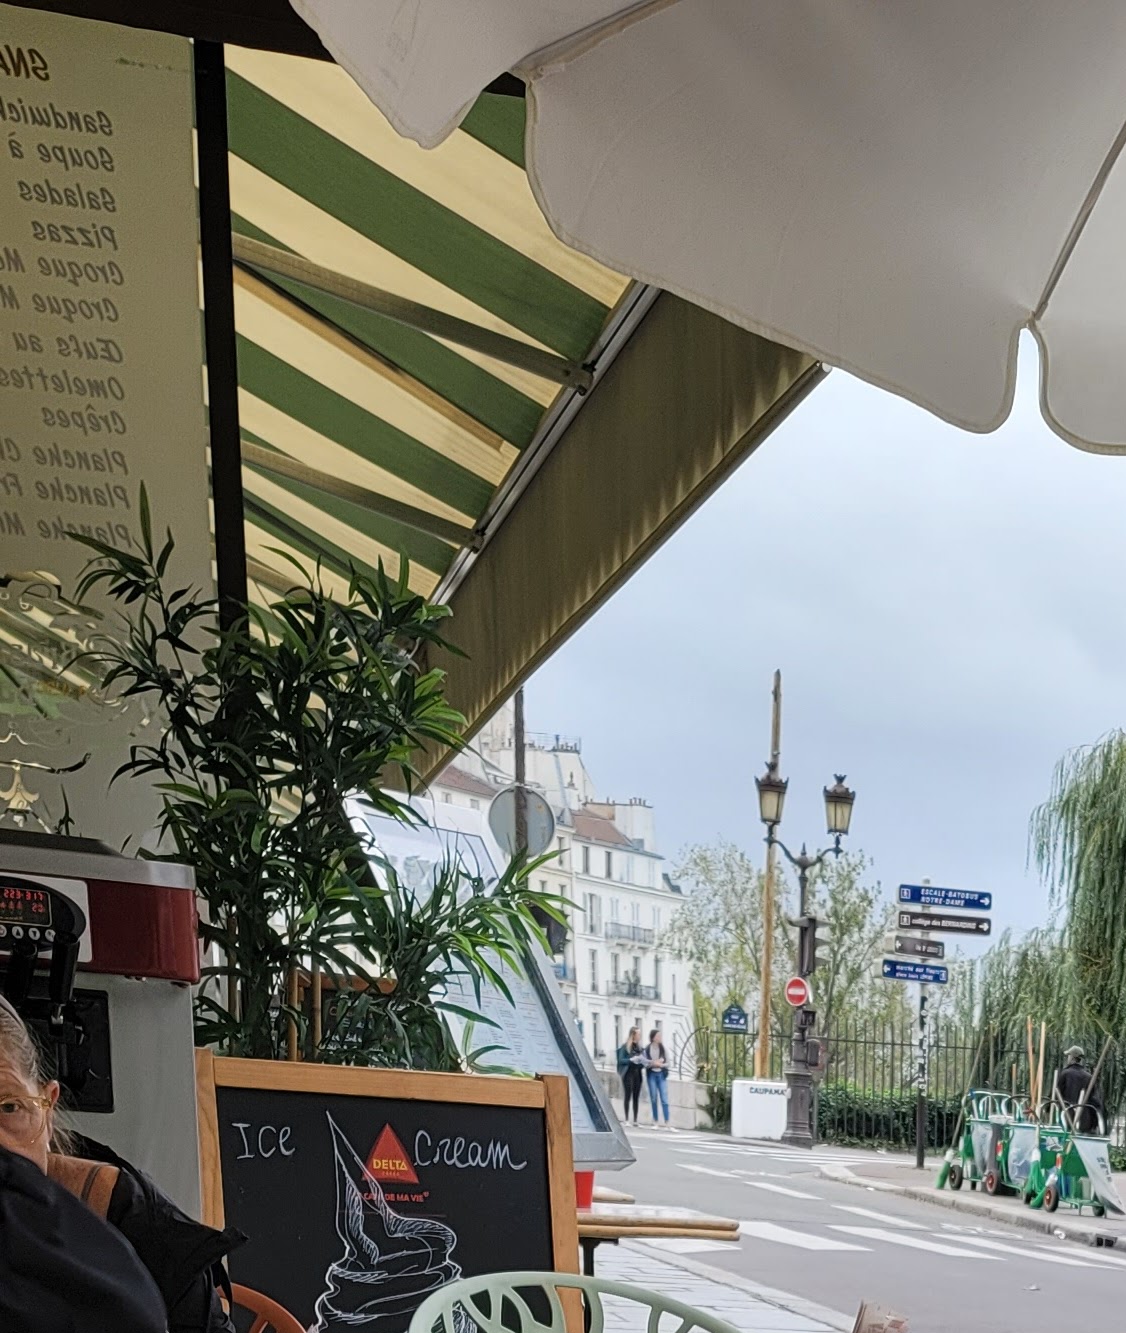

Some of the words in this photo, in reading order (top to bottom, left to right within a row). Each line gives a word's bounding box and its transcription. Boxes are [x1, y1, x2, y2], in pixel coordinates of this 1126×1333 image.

[231, 1122, 295, 1160] Ice
[414, 1129, 528, 1170] Cream
[372, 1158, 408, 1171] DELTA
